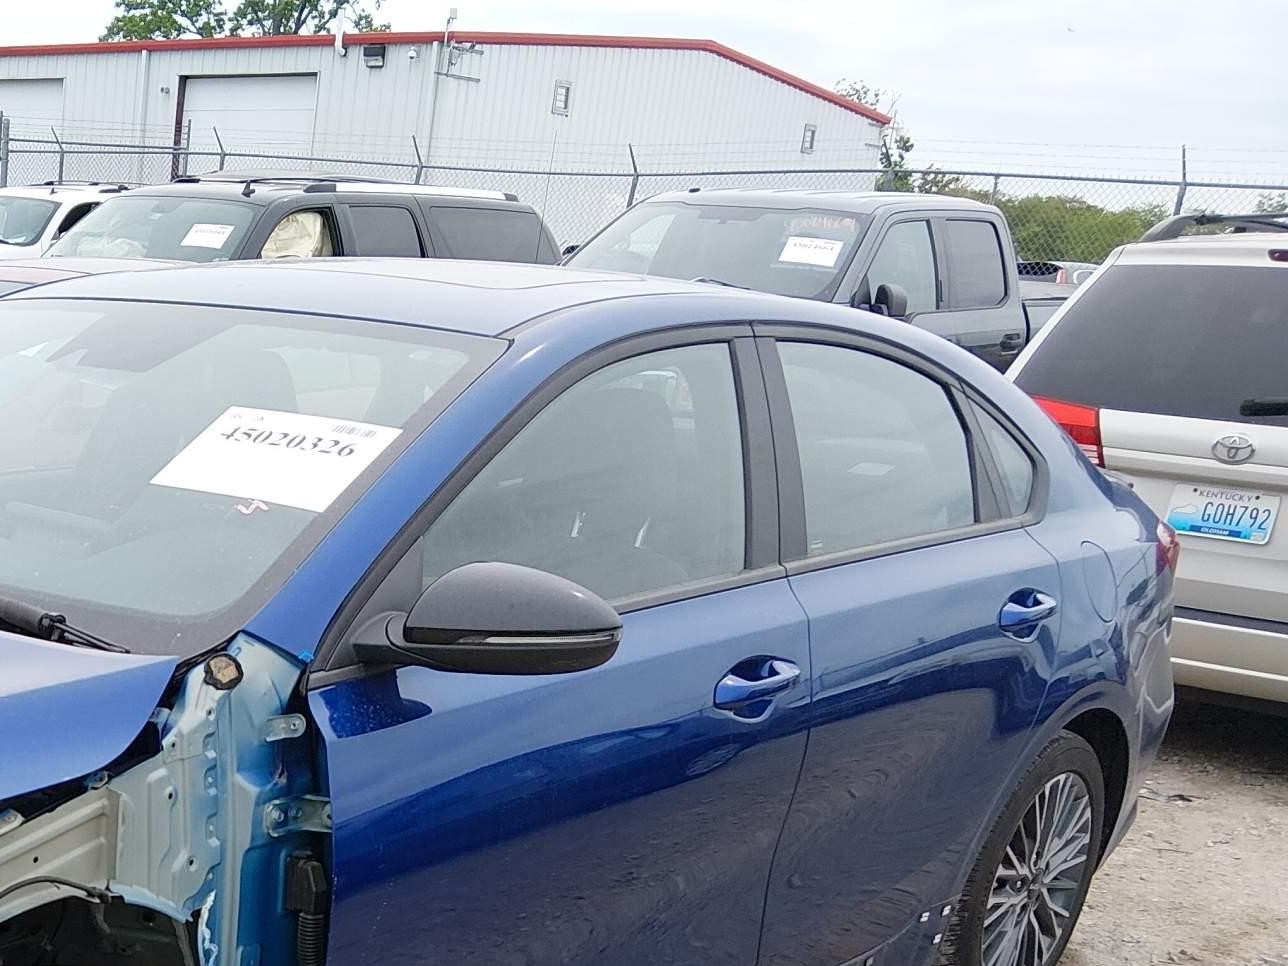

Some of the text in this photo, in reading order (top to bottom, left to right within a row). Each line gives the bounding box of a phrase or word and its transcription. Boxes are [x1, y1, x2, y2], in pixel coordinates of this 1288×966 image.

[220, 426, 355, 457] 45020326
[1198, 490, 1253, 502] KENTUCKY
[1201, 502, 1271, 530] GOH792
